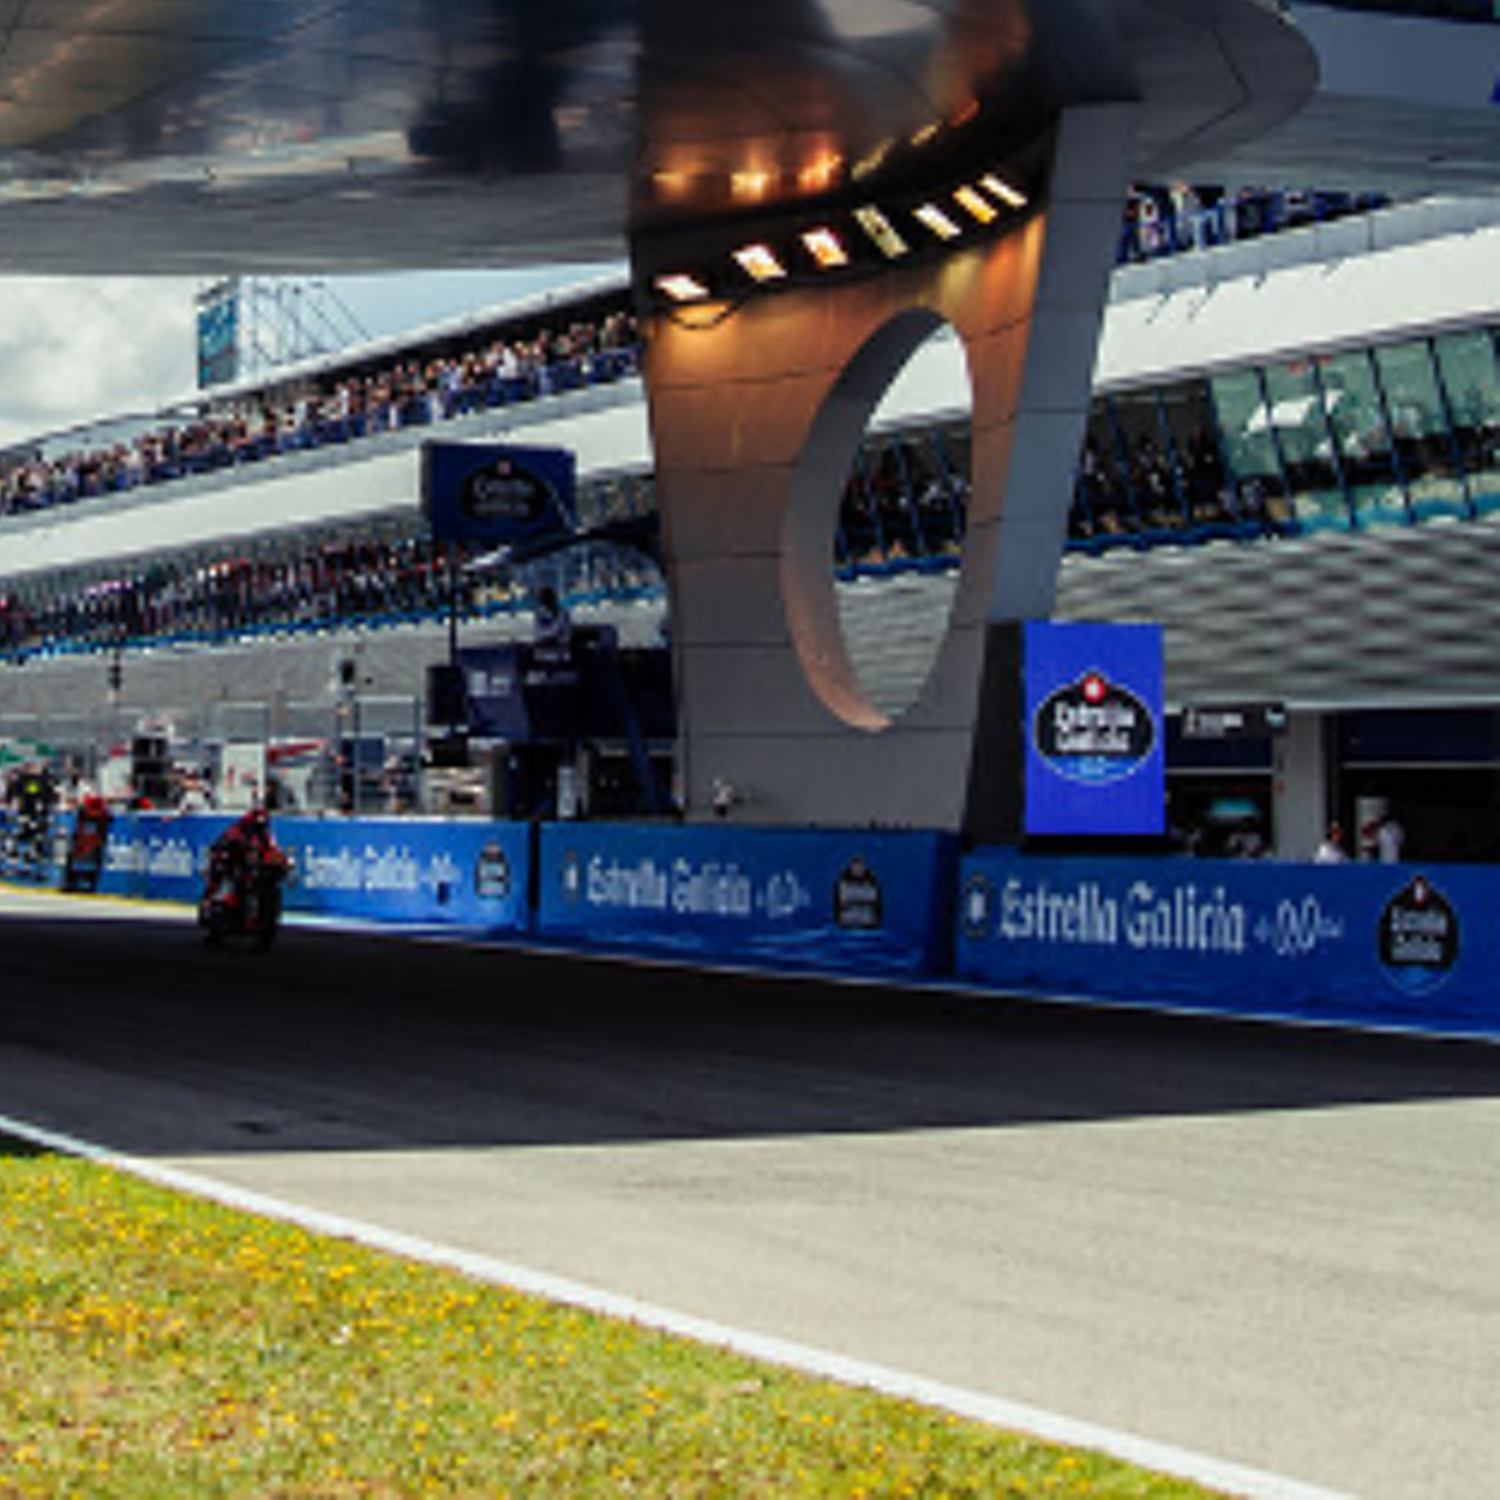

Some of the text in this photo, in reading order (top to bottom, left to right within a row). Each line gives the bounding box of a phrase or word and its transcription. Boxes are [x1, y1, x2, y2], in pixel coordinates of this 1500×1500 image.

[587, 855, 667, 908] Estrella
[670, 857, 751, 916] Galicia
[1001, 879, 1118, 945] Estrella
[1126, 881, 1246, 954] Galicia
